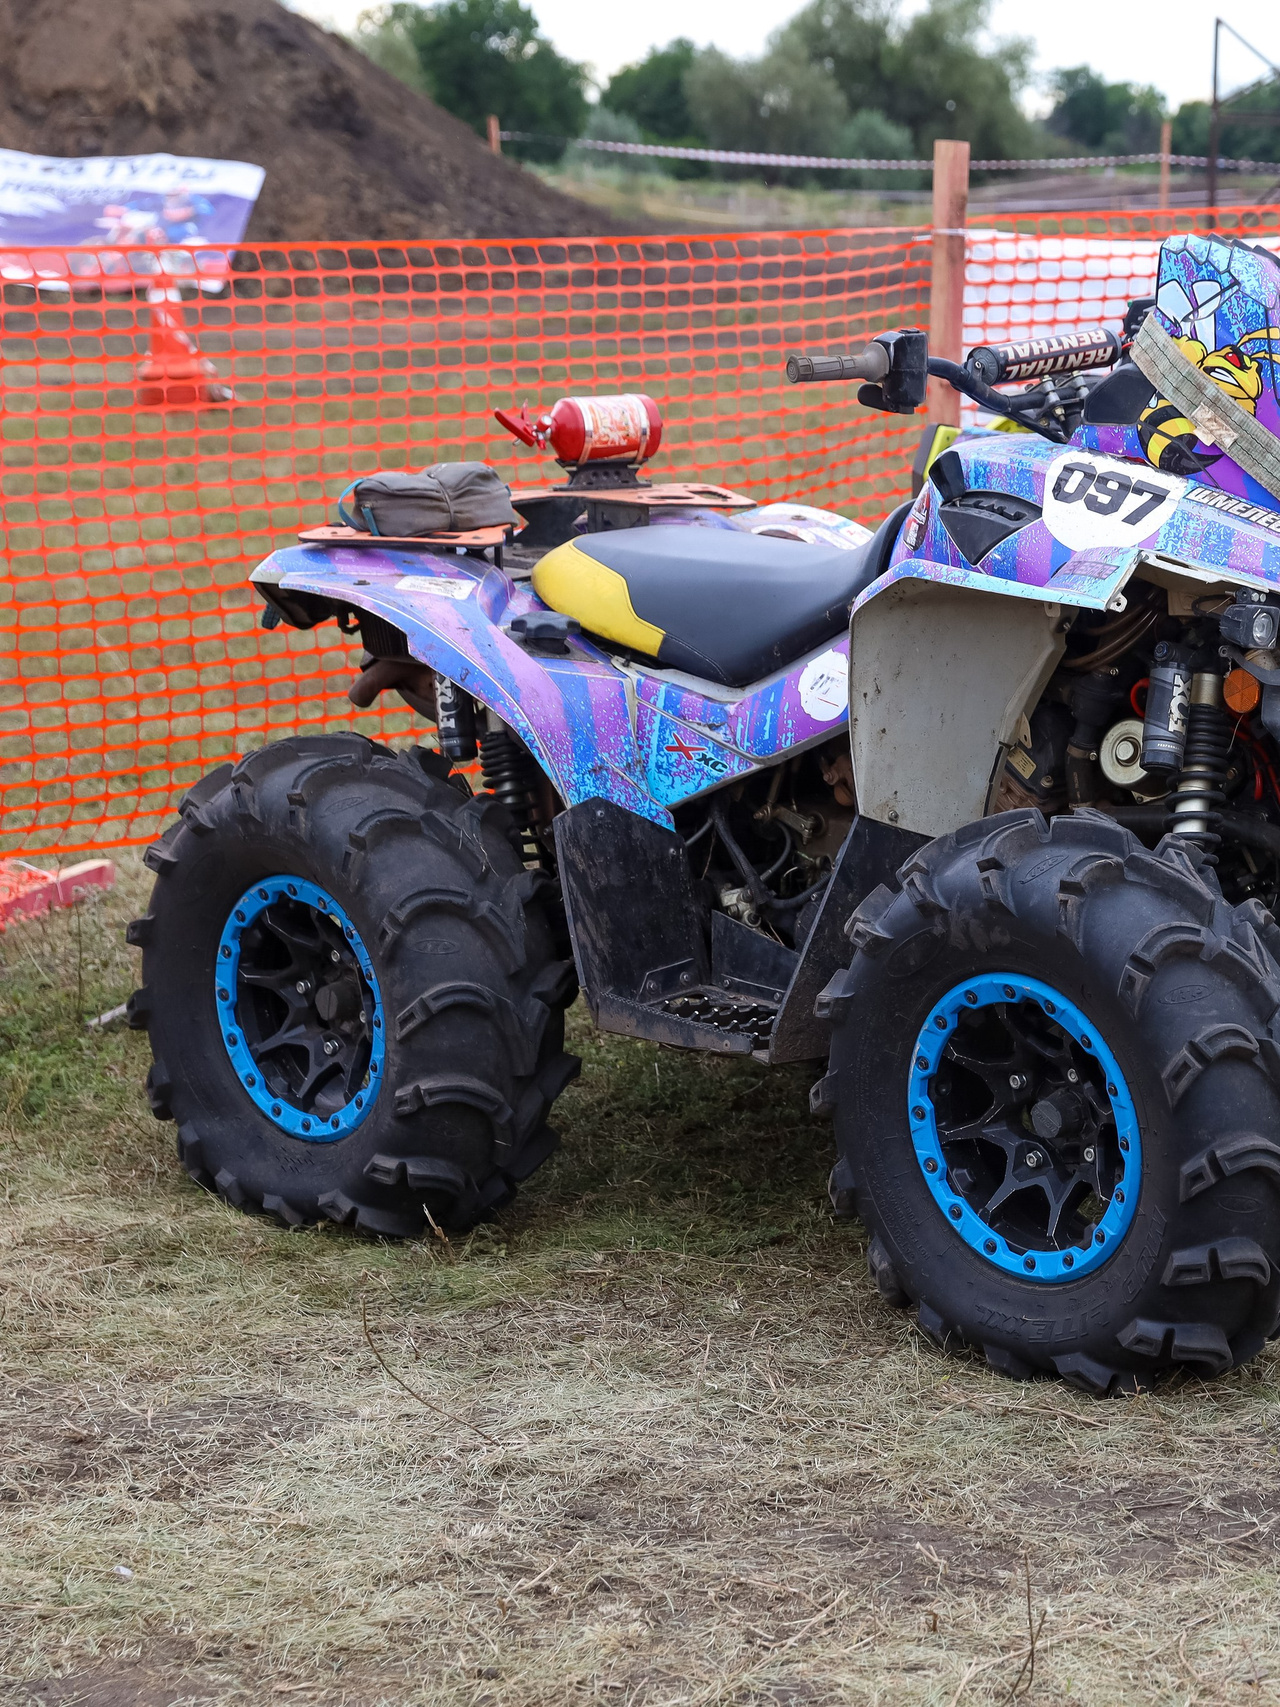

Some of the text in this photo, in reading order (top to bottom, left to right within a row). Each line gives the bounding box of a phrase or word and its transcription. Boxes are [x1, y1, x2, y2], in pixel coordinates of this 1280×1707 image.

[998, 329, 1108, 361] RENTHAL
[1005, 346, 1114, 380] RENTHAL
[1052, 461, 1171, 526] 097
[1167, 672, 1193, 737] FOX
[664, 732, 708, 761] X
